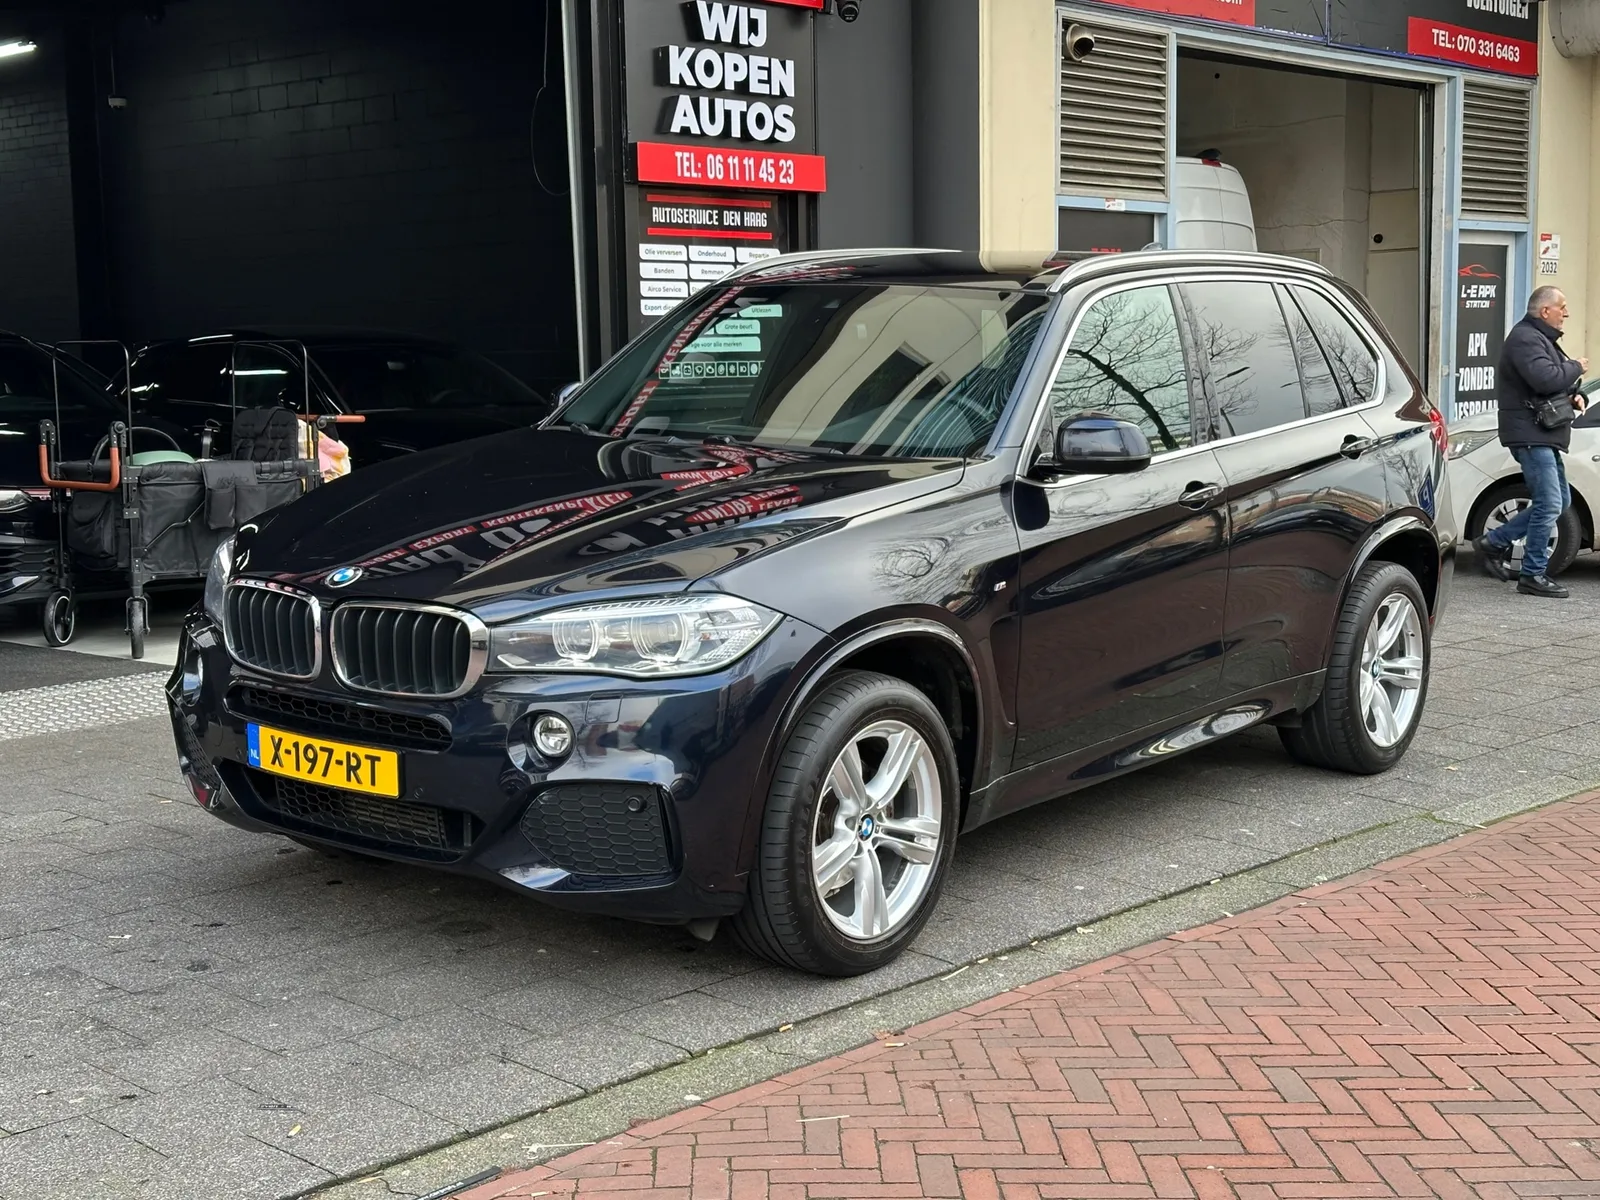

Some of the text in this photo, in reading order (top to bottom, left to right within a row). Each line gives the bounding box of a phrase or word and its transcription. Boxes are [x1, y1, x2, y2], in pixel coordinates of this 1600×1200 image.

[697, 0, 767, 47] WIJ
[1431, 28, 1520, 62] TEL: 070 331 6463
[669, 44, 795, 97] KOPEN
[670, 94, 796, 142] AUTOS
[675, 151, 794, 184] TEL: 06 11 11 45 23
[652, 206, 768, 228] AUTOSERVICE DEN HAAG
[644, 248, 656, 256] Olie
[697, 250, 727, 258] Onderhoud
[653, 267, 675, 275] Banden
[700, 268, 725, 276] Remmen
[1541, 261, 1558, 273] 2032
[1478, 284, 1497, 298] APK
[644, 304, 662, 312] Export
[1465, 300, 1491, 309] STATION
[1467, 332, 1488, 357] APK
[1458, 366, 1495, 391] ZONDER
[249, 748, 260, 760] NL
[270, 735, 382, 787] X-197-RT
